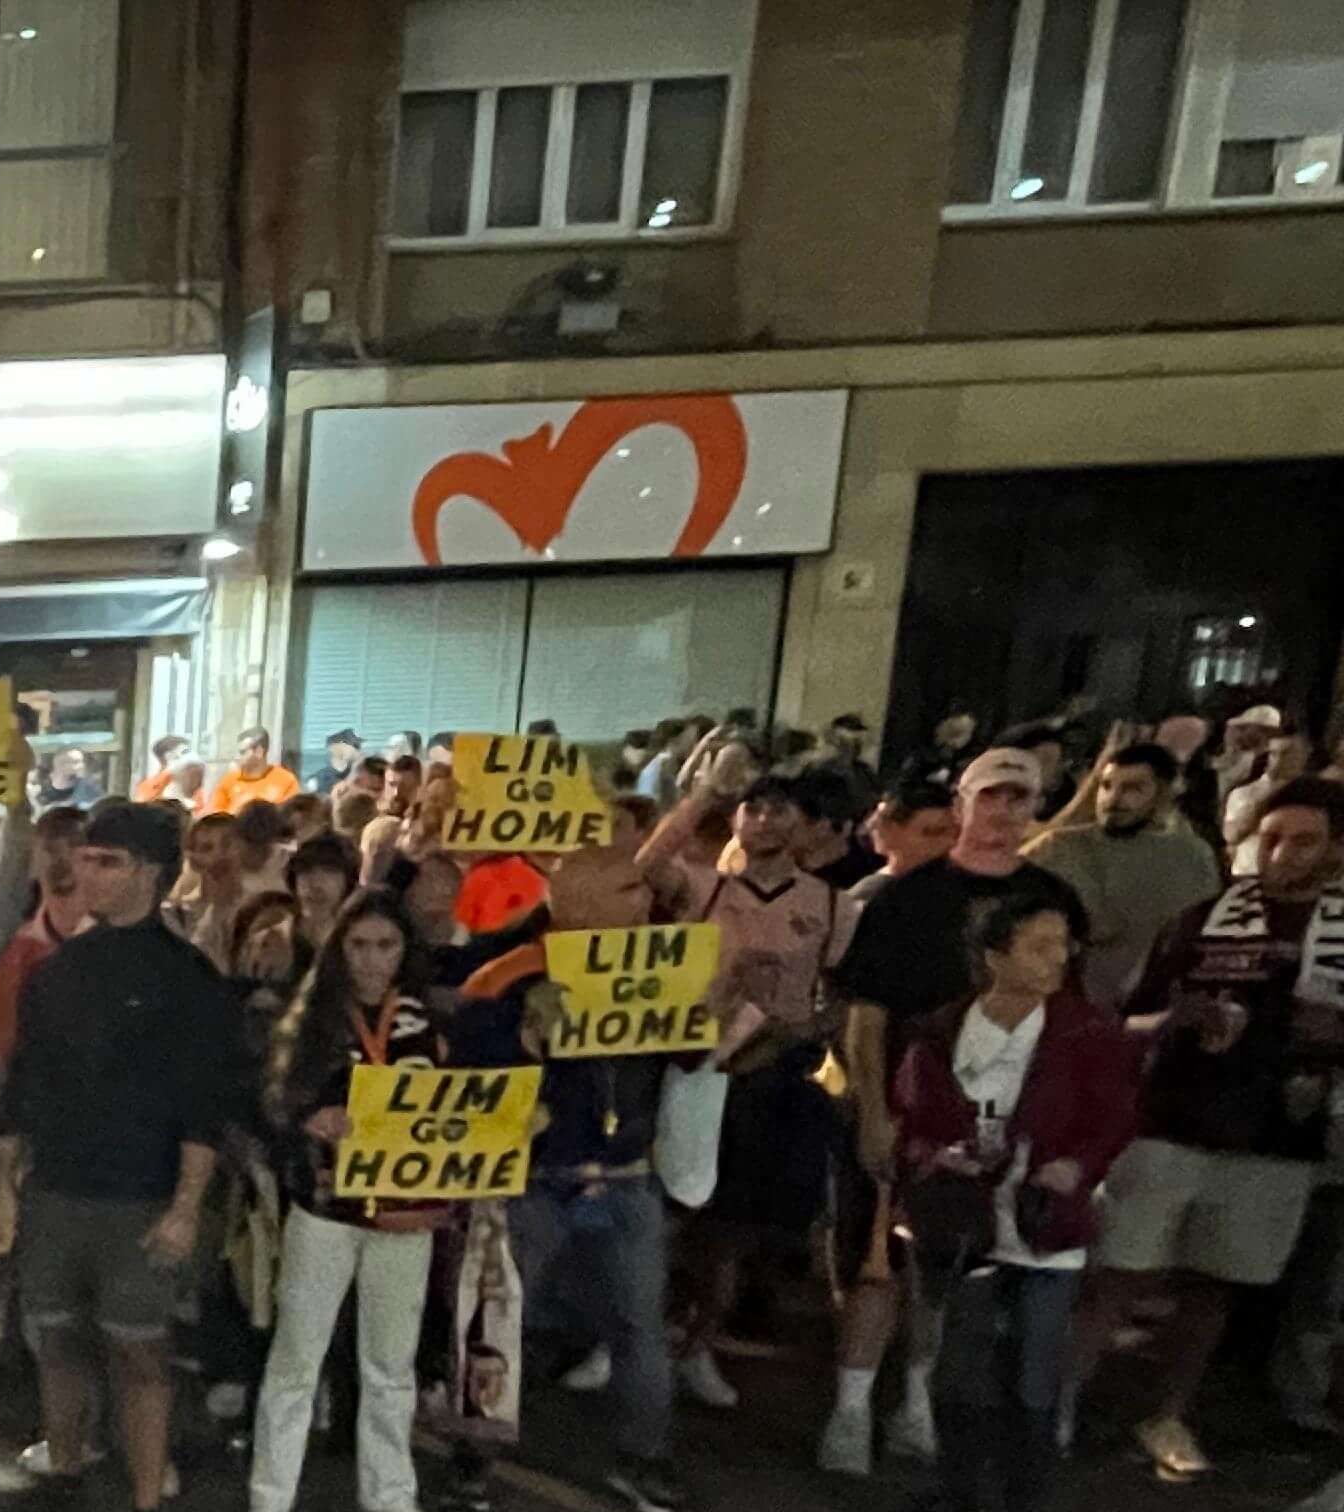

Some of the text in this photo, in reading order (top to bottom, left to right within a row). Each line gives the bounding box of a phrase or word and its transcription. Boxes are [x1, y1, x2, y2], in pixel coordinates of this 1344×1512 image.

[482, 735, 579, 777] LIM
[506, 778, 555, 803] GO
[446, 808, 606, 845] HOME
[584, 928, 687, 974] LIM
[612, 976, 662, 1004] GO
[559, 1005, 709, 1049] HOME
[386, 1073, 511, 1114] LIM
[410, 1117, 469, 1144] GO
[343, 1149, 521, 1190] HOME
